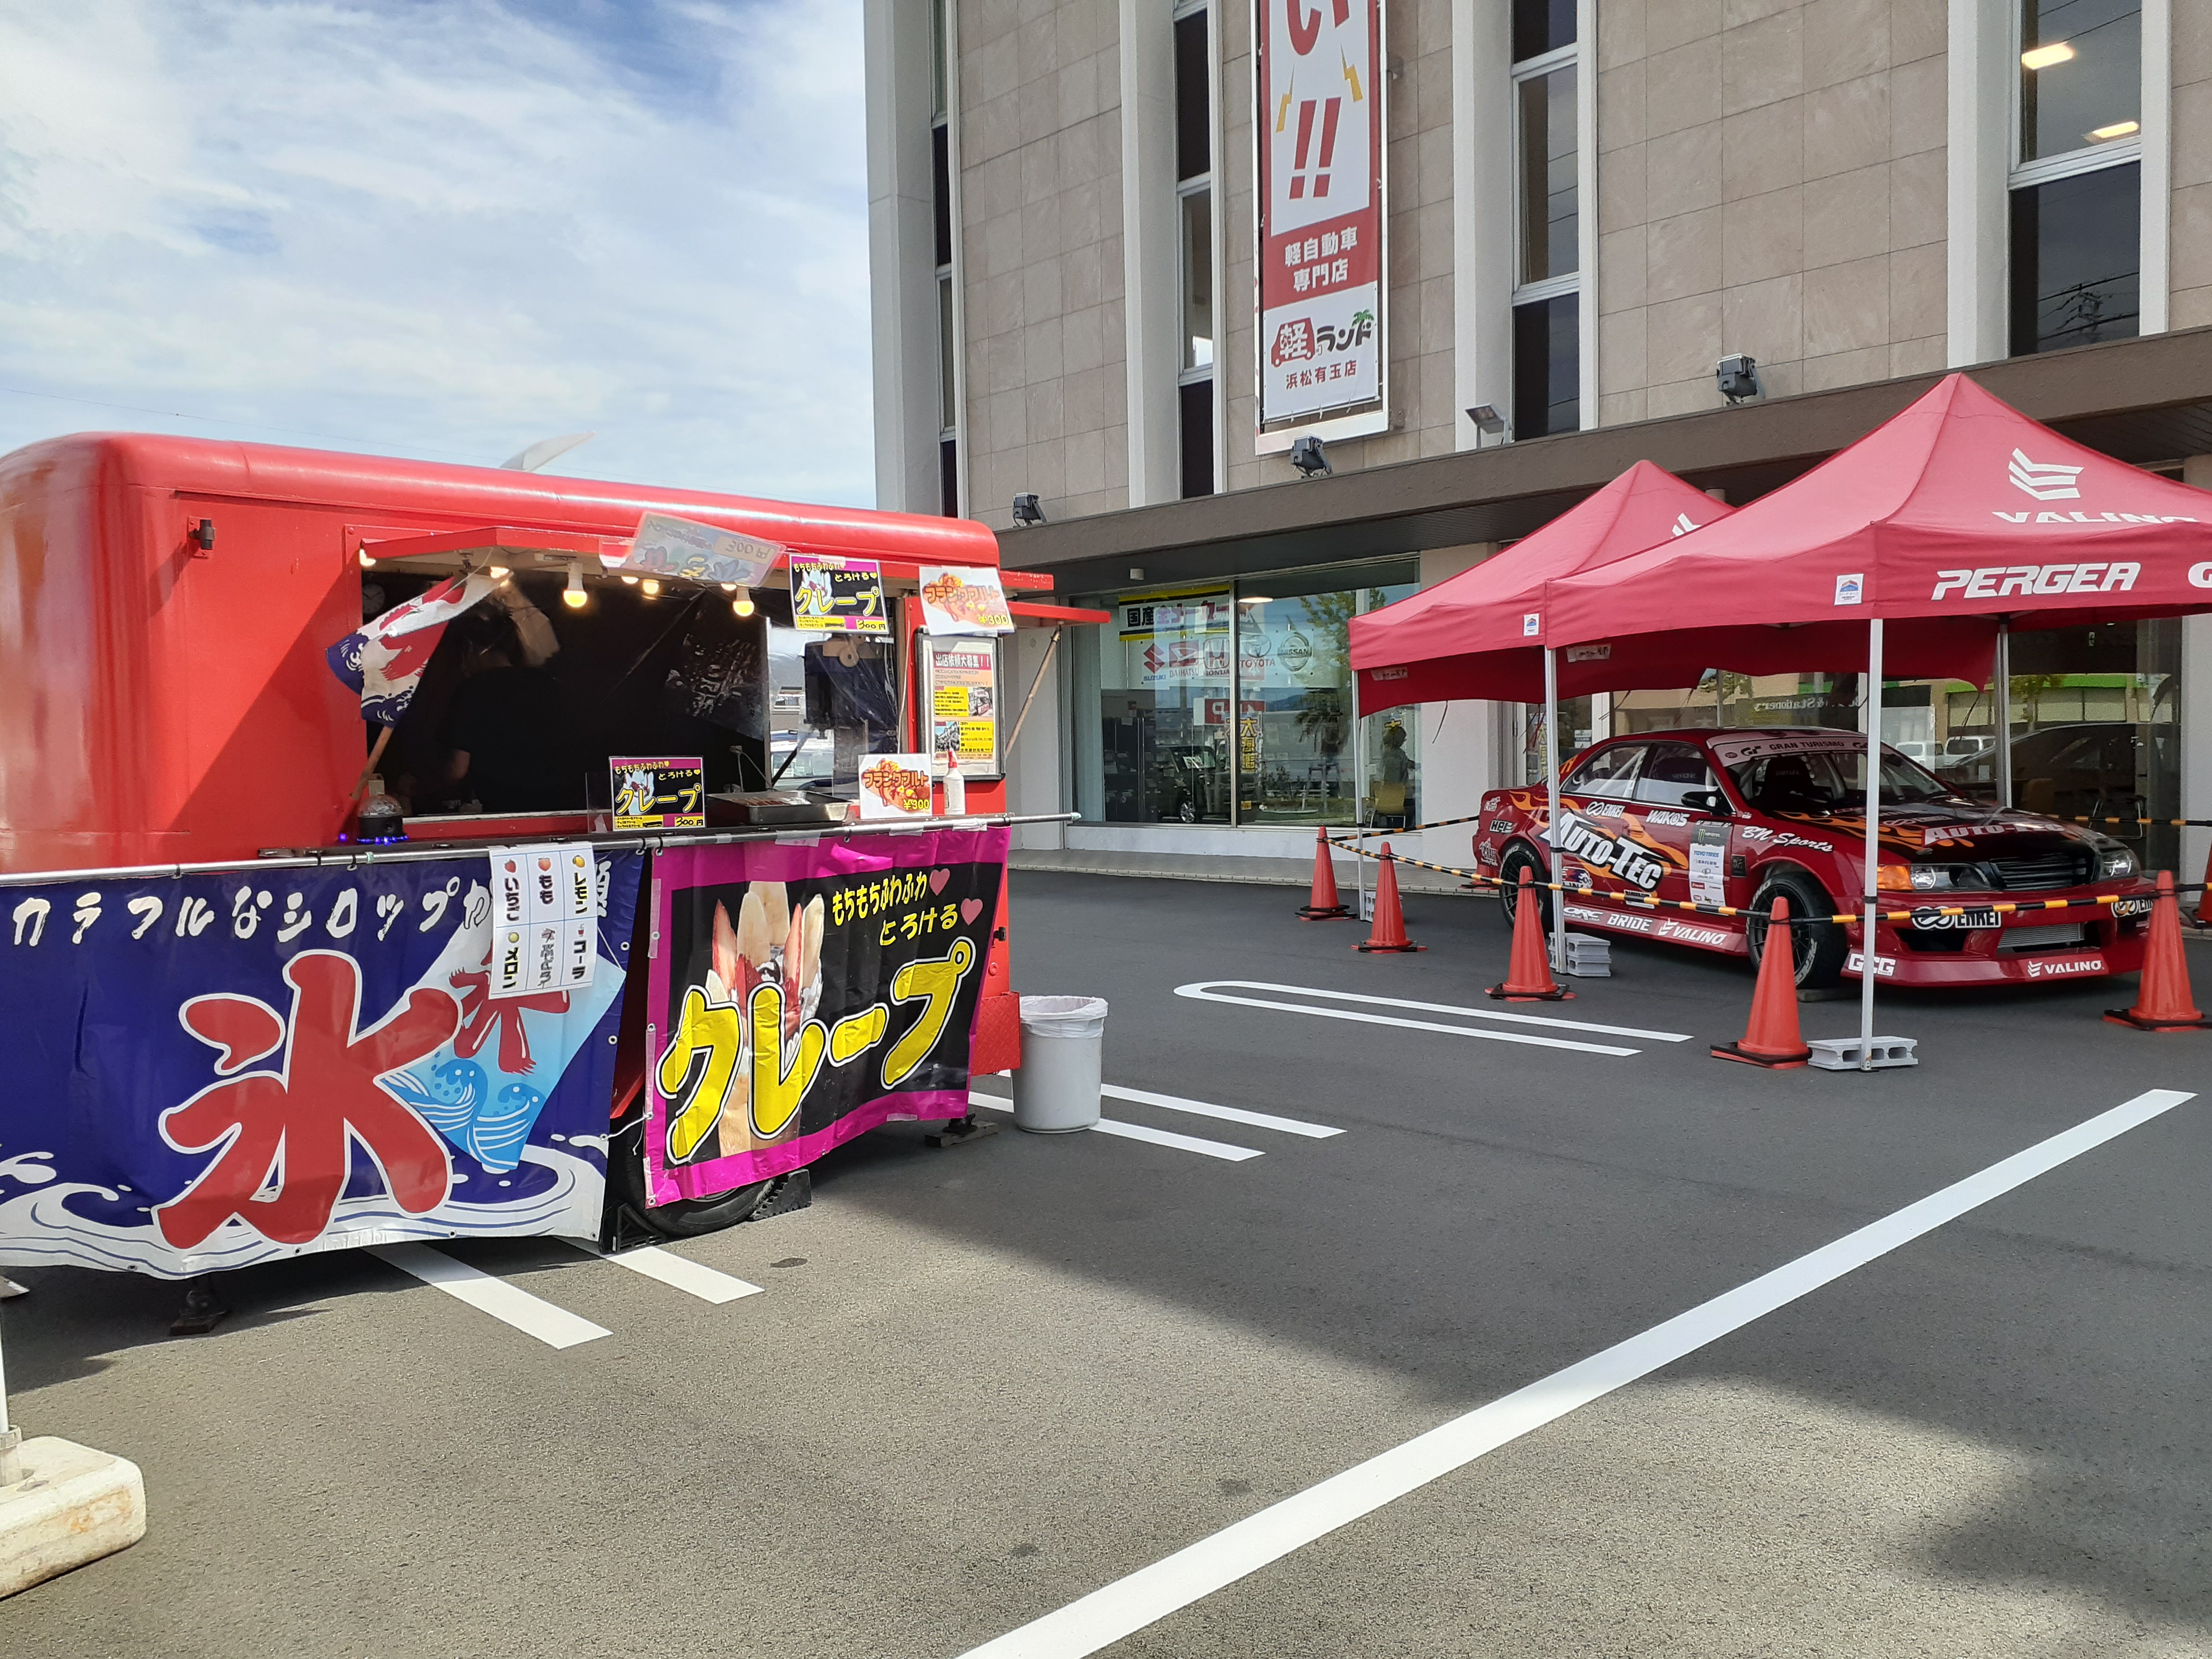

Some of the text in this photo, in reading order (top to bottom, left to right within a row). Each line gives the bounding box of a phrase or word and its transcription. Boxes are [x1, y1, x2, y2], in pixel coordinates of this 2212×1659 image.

[1285, 226, 1357, 267] 軽自動車
[1294, 258, 1348, 292] 専門店
[1280, 320, 1372, 359] 軽ランド
[1286, 360, 1357, 390] 浜松有玉店
[835, 573, 869, 582] とろける
[1931, 562, 2141, 601] PERGEA
[795, 586, 880, 617] クレープ
[924, 585, 1000, 604] フランクフルト
[977, 614, 1009, 625] ¥300
[1169, 668, 1199, 678] DAIHATSU
[1239, 657, 1276, 668] TOYOTA
[1769, 742, 1799, 750] GRAN
[615, 762, 664, 774] もちもちふわふわ
[658, 769, 693, 780] とろける
[864, 770, 929, 788] フランクフルト
[616, 783, 702, 816] クレープ
[903, 799, 930, 810] ¥300
[1646, 810, 1690, 827] WAKO'S
[1540, 812, 1664, 890] AUTO-TEC
[1773, 832, 1834, 852] Sports
[505, 877, 520, 922] いちご
[539, 875, 554, 905] もも
[574, 872, 588, 915] レモン
[832, 871, 927, 927] もちもちふわふわ
[880, 903, 958, 946] とろける
[1608, 913, 1654, 932] BRIDE
[1672, 927, 1728, 945] VALINO
[502, 946, 520, 989] メロン
[572, 939, 587, 980] コーラ
[2044, 960, 2103, 974] VALINO
[656, 936, 976, 1164] クレープ
[158, 948, 463, 1250] 氷
